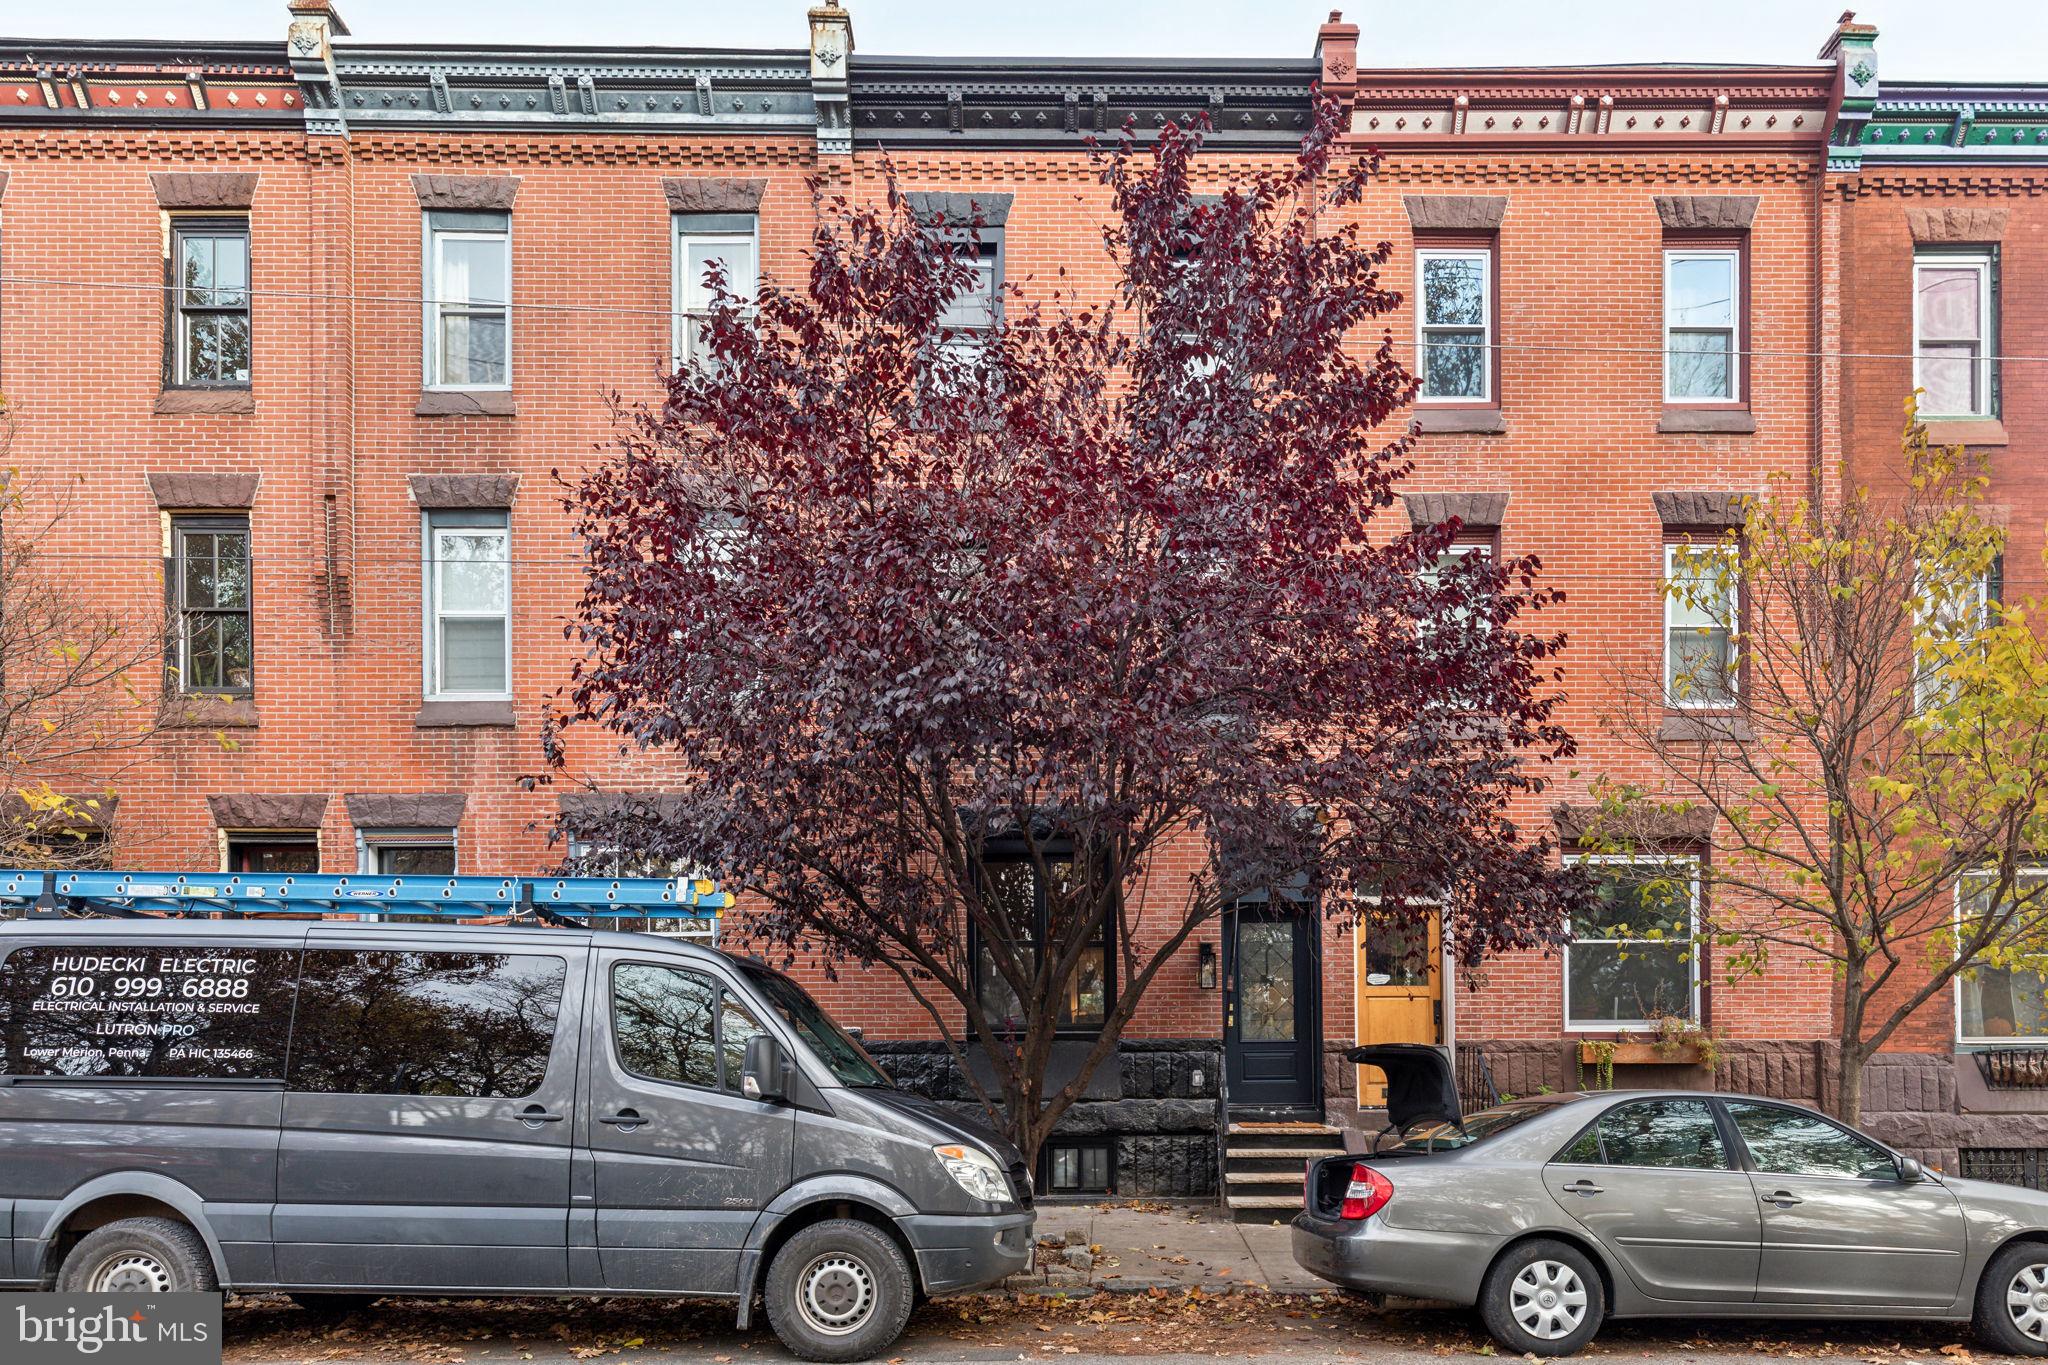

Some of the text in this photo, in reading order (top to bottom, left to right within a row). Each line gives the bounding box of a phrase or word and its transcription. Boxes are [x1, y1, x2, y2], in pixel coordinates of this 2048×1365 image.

[52, 957, 256, 973] HUDECKI ELECTRIC
[182, 979, 249, 998] 6888
[32, 1001, 260, 1014] ELECTRICAL INSTALLATION & SERVICE
[96, 1023, 195, 1036] LUTRON PRO
[23, 1047, 60, 1057] Lower
[62, 1047, 105, 1058] Merion,
[169, 1049, 253, 1058] PA HIC 135466
[724, 1197, 753, 1205] 2500
